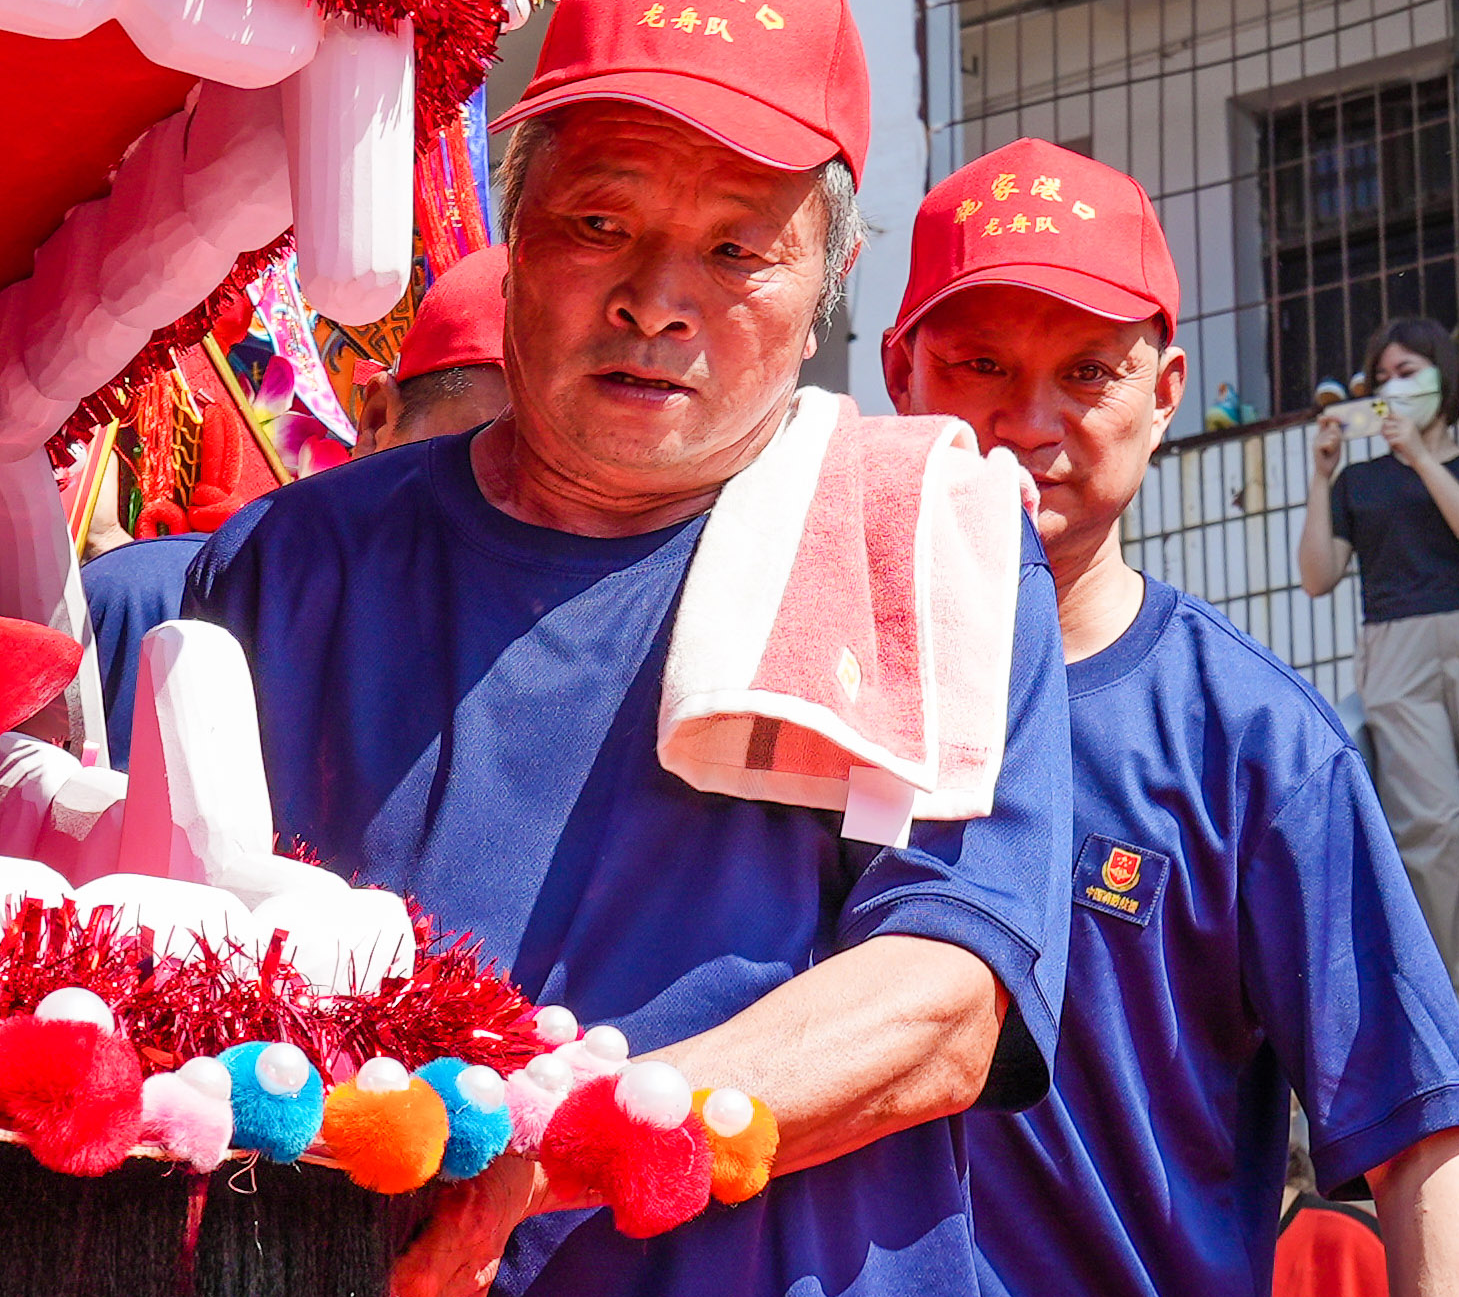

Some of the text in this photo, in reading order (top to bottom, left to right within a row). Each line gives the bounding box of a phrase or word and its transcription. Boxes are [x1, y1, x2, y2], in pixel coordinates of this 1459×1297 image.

[636, 2, 735, 43] 龙舟队
[952, 173, 1096, 224] 施家港口
[980, 212, 1061, 238] 龙舟队
